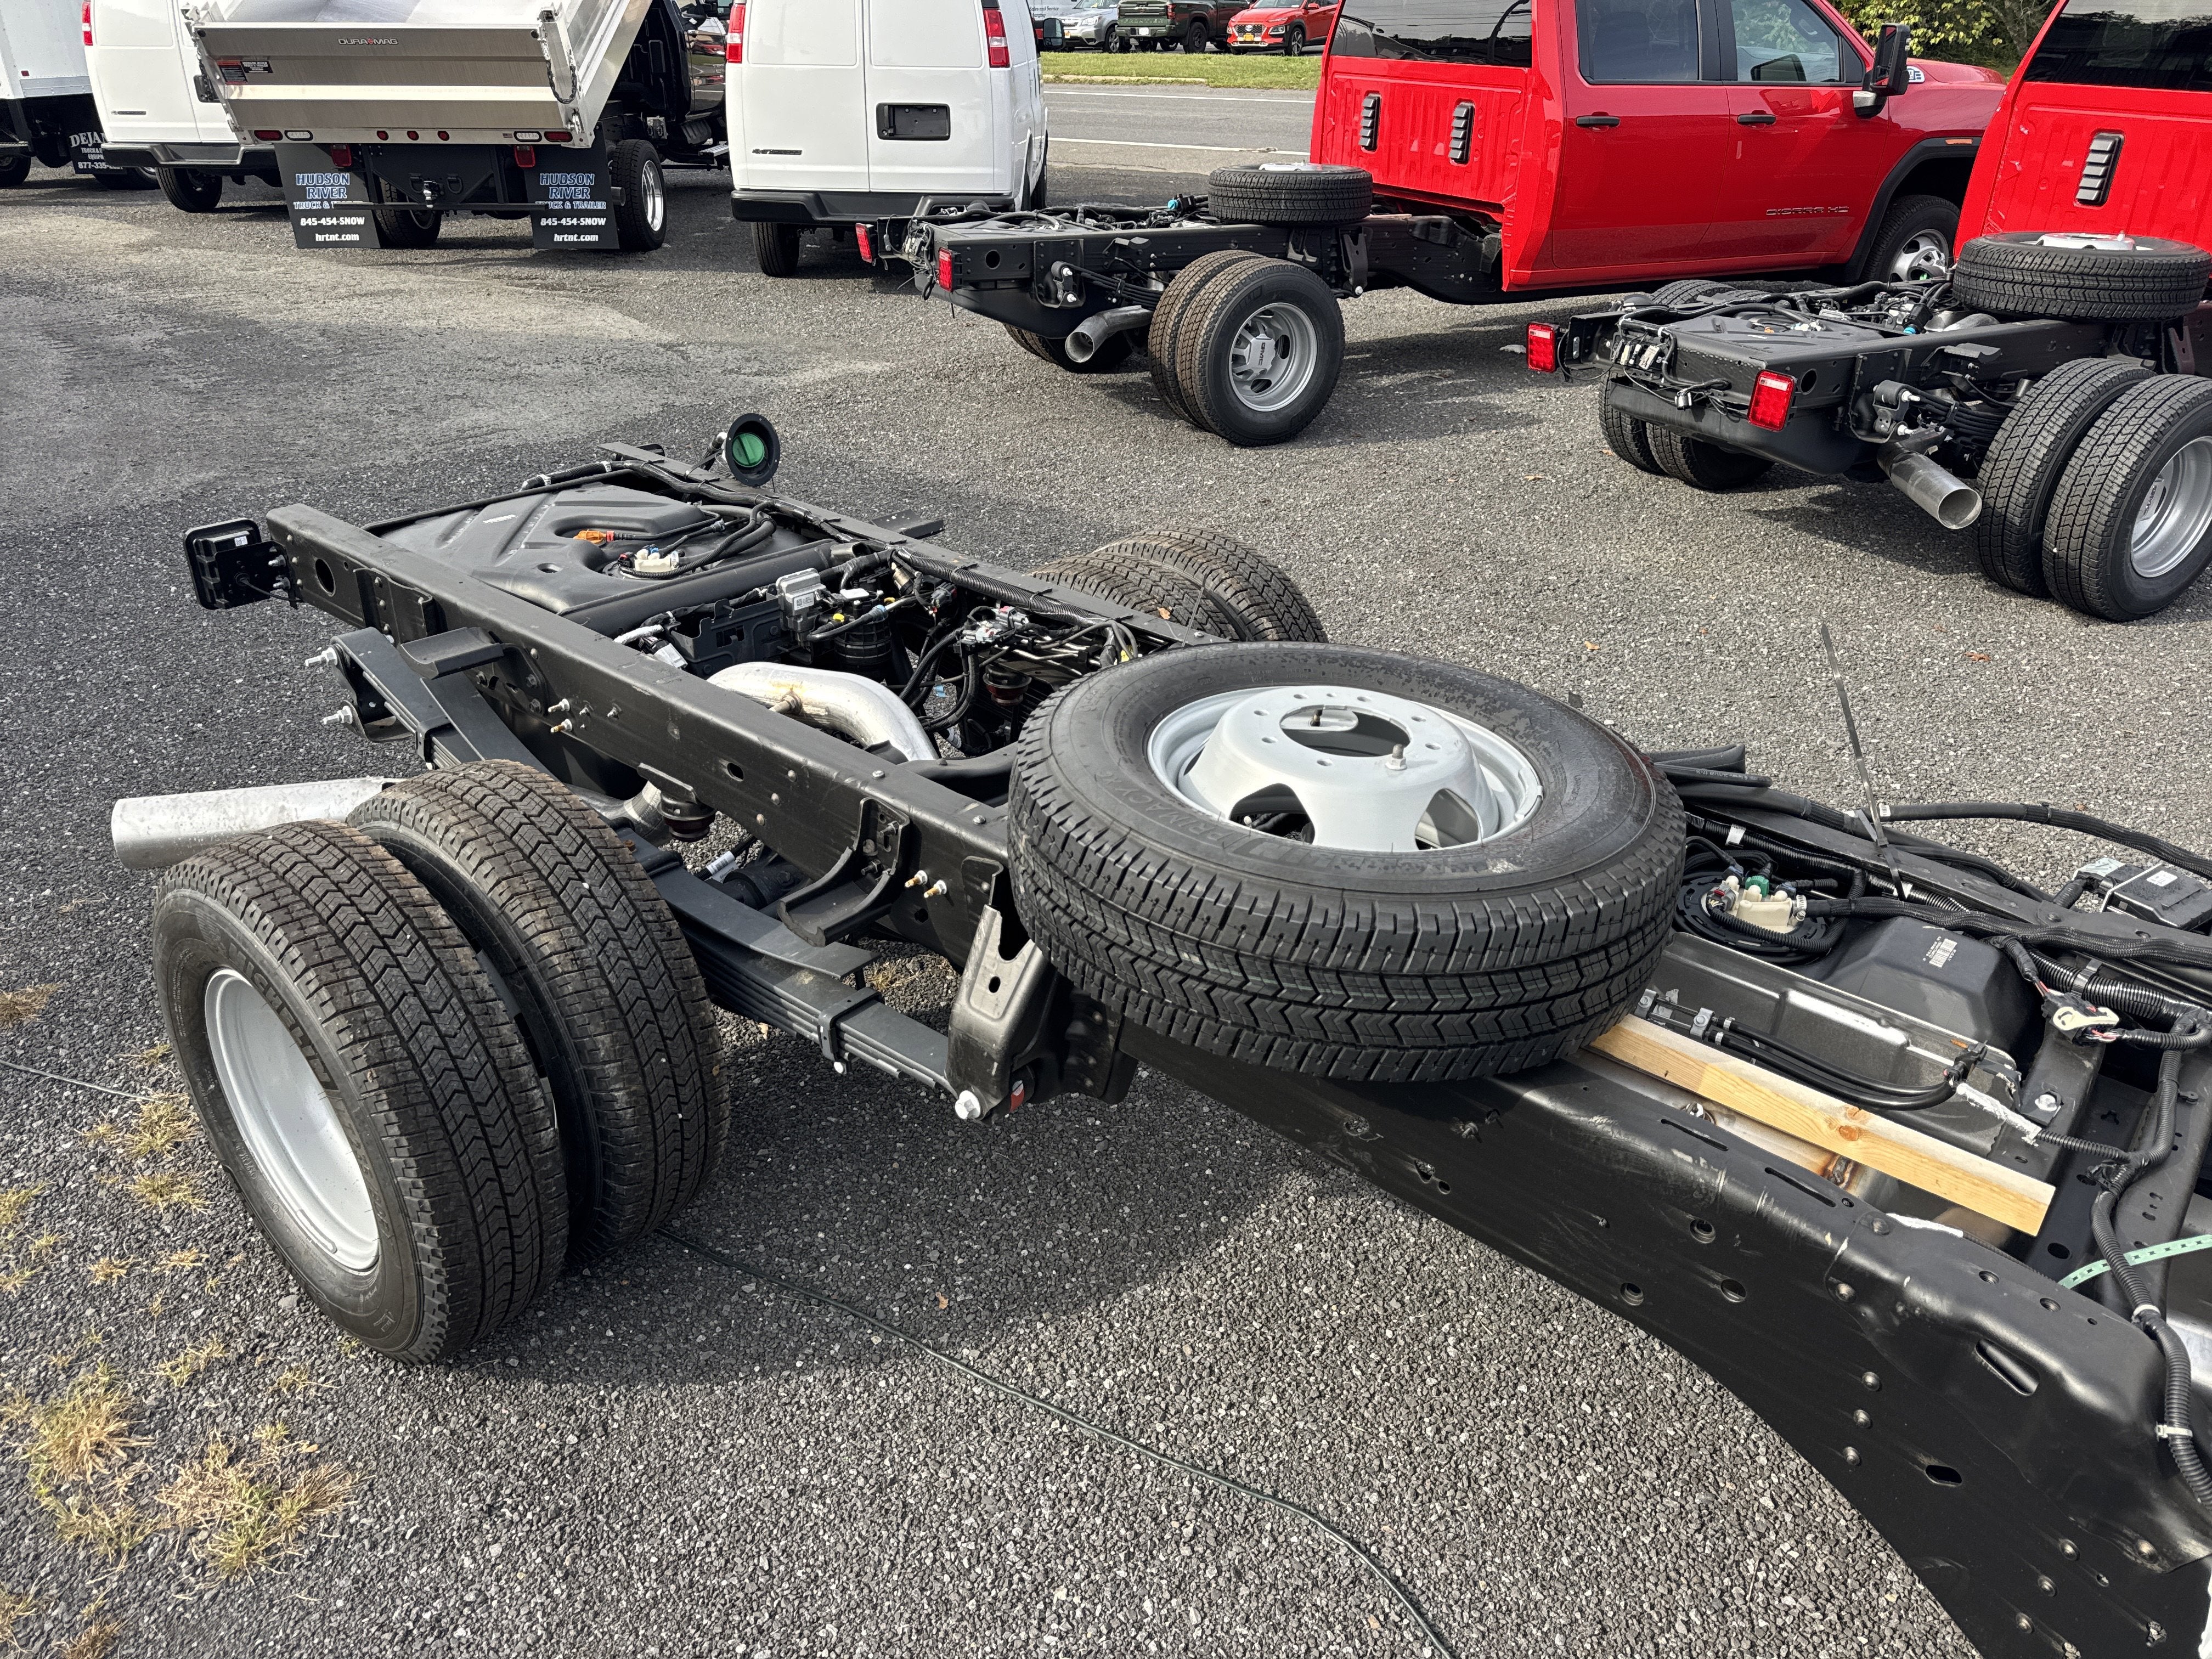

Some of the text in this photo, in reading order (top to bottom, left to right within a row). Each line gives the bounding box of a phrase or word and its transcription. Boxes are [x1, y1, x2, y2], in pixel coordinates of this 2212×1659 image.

[78, 161, 123, 170] 877-335-
[296, 173, 350, 185] HUDSON
[540, 173, 595, 185] HUDSON
[306, 187, 347, 199] RIVER
[549, 187, 590, 199] RIVER
[573, 201, 606, 210] TRAILER
[1766, 207, 1824, 216] SIERRA
[300, 217, 365, 225] 845-454-SNOW
[540, 217, 606, 225] 845-454-SNOW
[315, 233, 359, 241] hrtnt.com
[554, 233, 599, 241] hrtnt.com
[1258, 342, 1266, 366] GMC
[1115, 786, 1233, 844] PRIMACY
[228, 943, 334, 1087] MICHELIN
